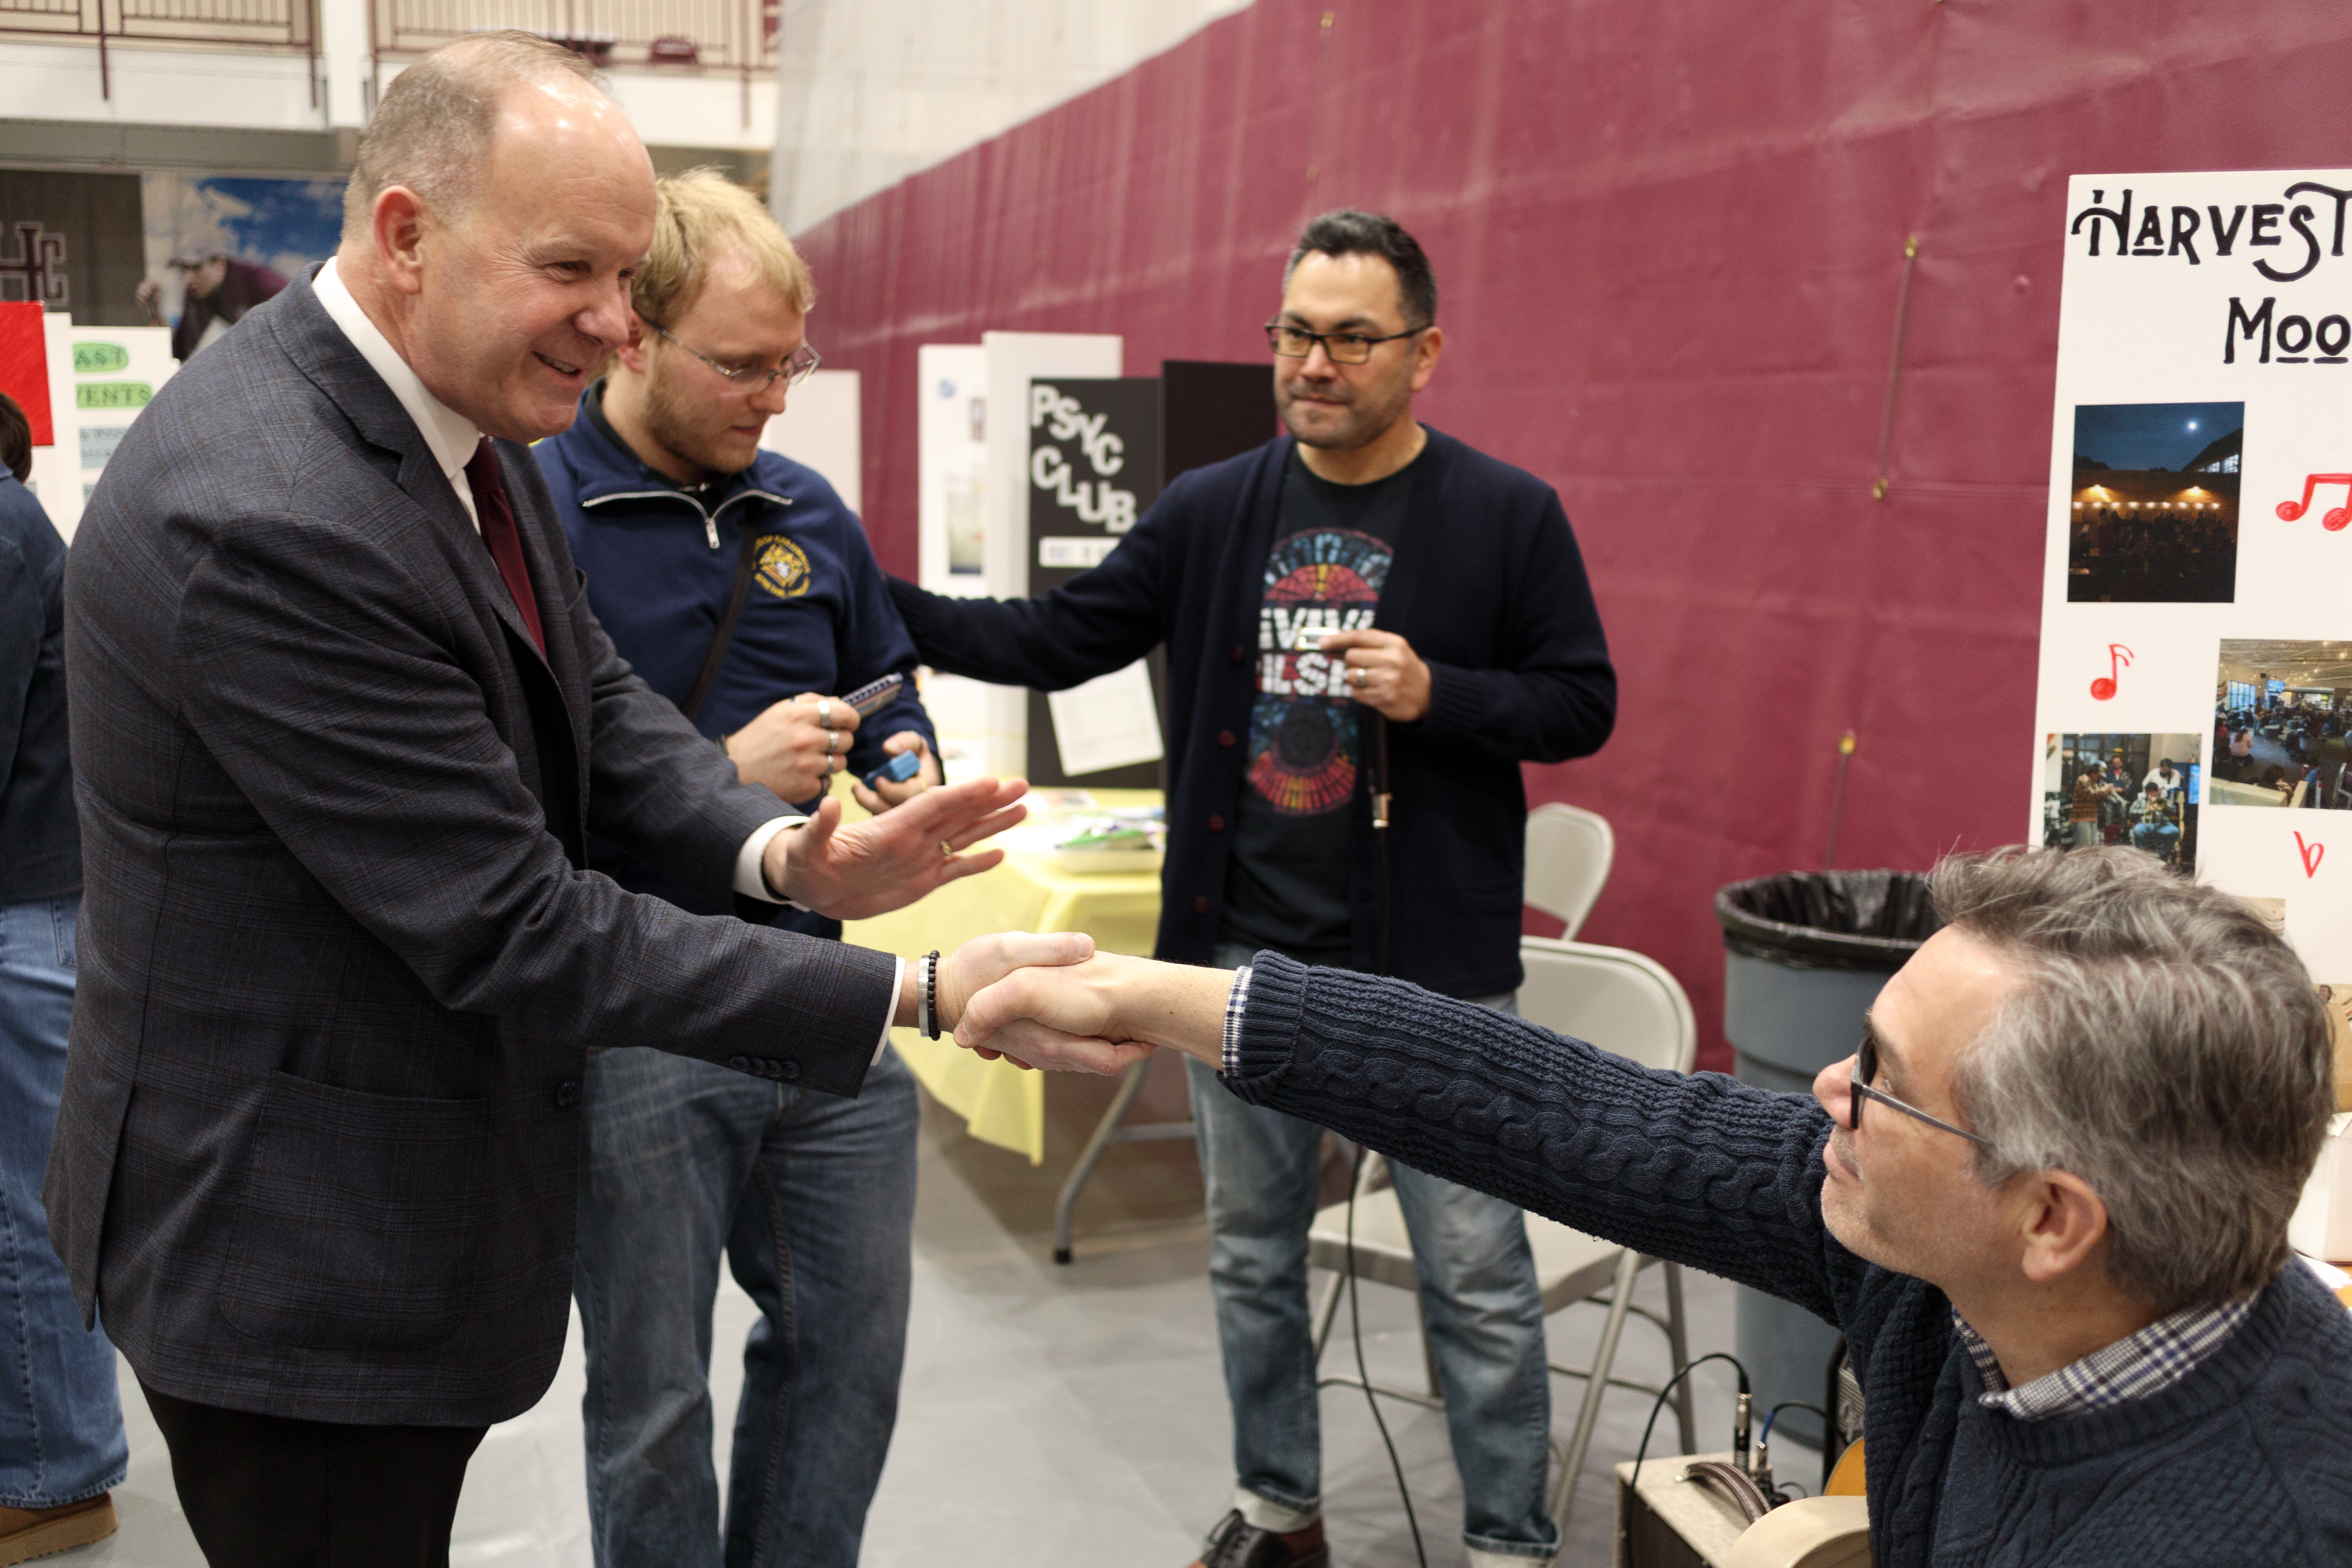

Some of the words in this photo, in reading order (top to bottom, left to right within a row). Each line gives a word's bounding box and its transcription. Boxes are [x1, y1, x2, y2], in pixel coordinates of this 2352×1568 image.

[2071, 181, 2352, 282] HARVEST
[1031, 384, 1124, 475] PSYC
[1031, 444, 1138, 533] CLUB
